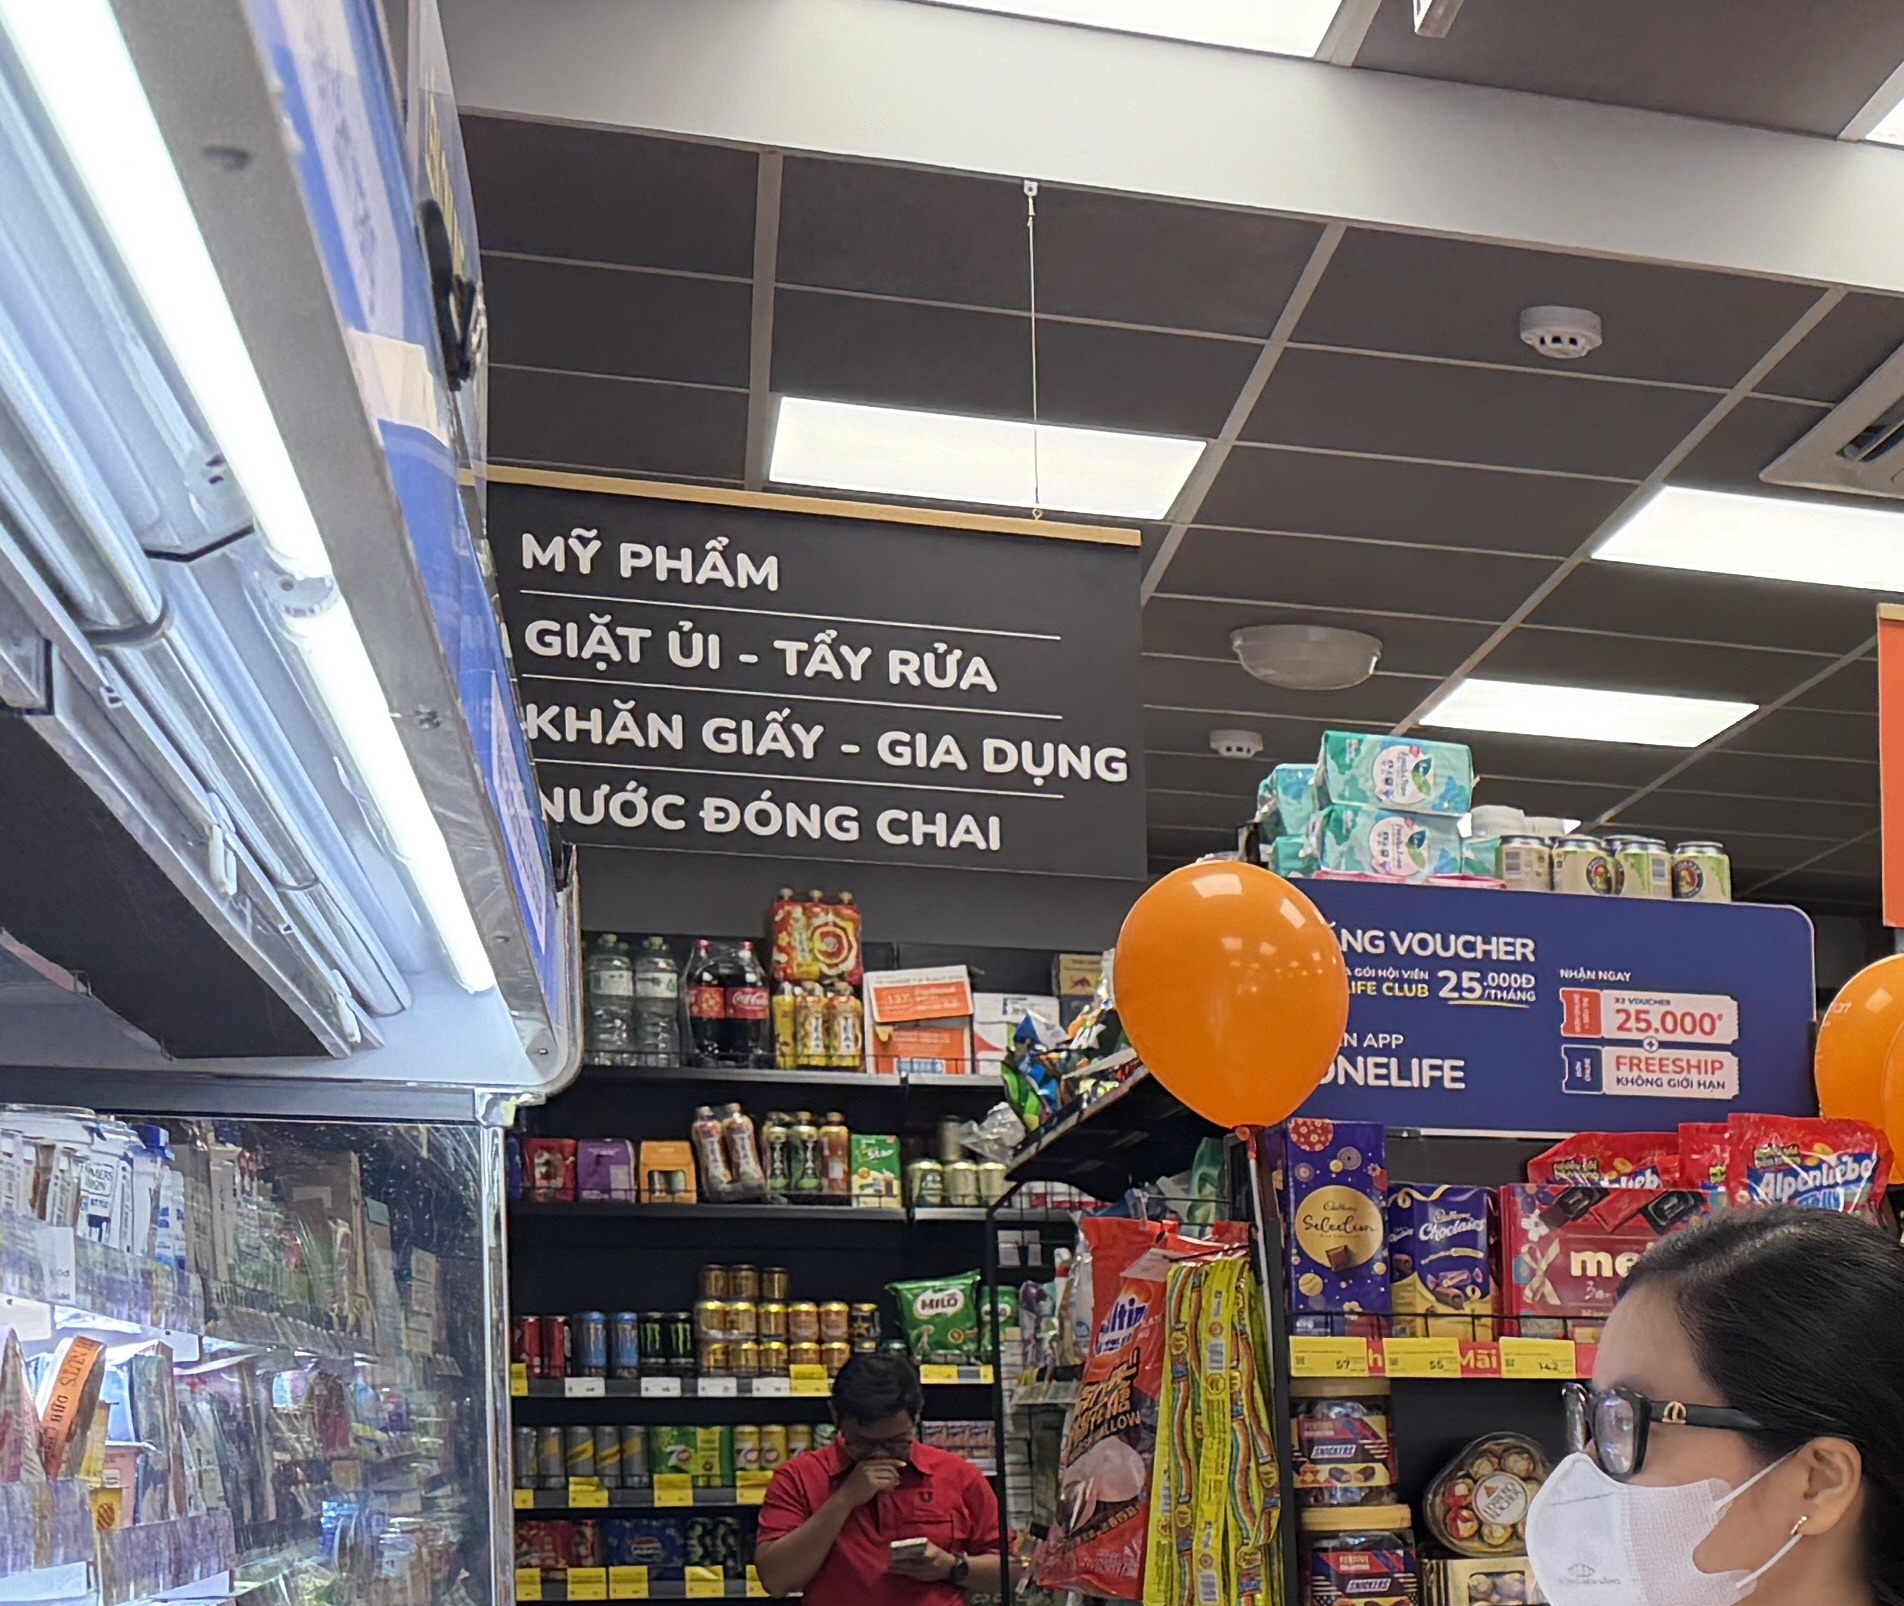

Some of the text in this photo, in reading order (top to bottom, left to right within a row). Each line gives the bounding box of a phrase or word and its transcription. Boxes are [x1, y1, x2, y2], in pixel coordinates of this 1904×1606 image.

[522, 526, 779, 591] MỸ PHẨM
[525, 614, 651, 671] GIẶT
[669, 621, 720, 669] ỦI
[774, 631, 870, 682] TẨY
[889, 641, 998, 693] RỬA
[528, 701, 683, 749] KHĂN
[702, 709, 823, 759] GIẤY
[878, 731, 967, 771] GIA
[984, 738, 1128, 785] DỤNG
[699, 791, 859, 841] ĐÓNG
[878, 809, 1001, 851] CHAI
[1389, 930, 1535, 962] VOUCHER
[1560, 967, 1631, 982] NHẬN NGAY
[1382, 983, 1429, 997] CLUB
[1363, 1034, 1403, 1048] APP
[1616, 1055, 1724, 1075] FREESHIP
[1616, 1075, 1663, 1088] KHÔNG
[1698, 1079, 1725, 1092] HẠN
